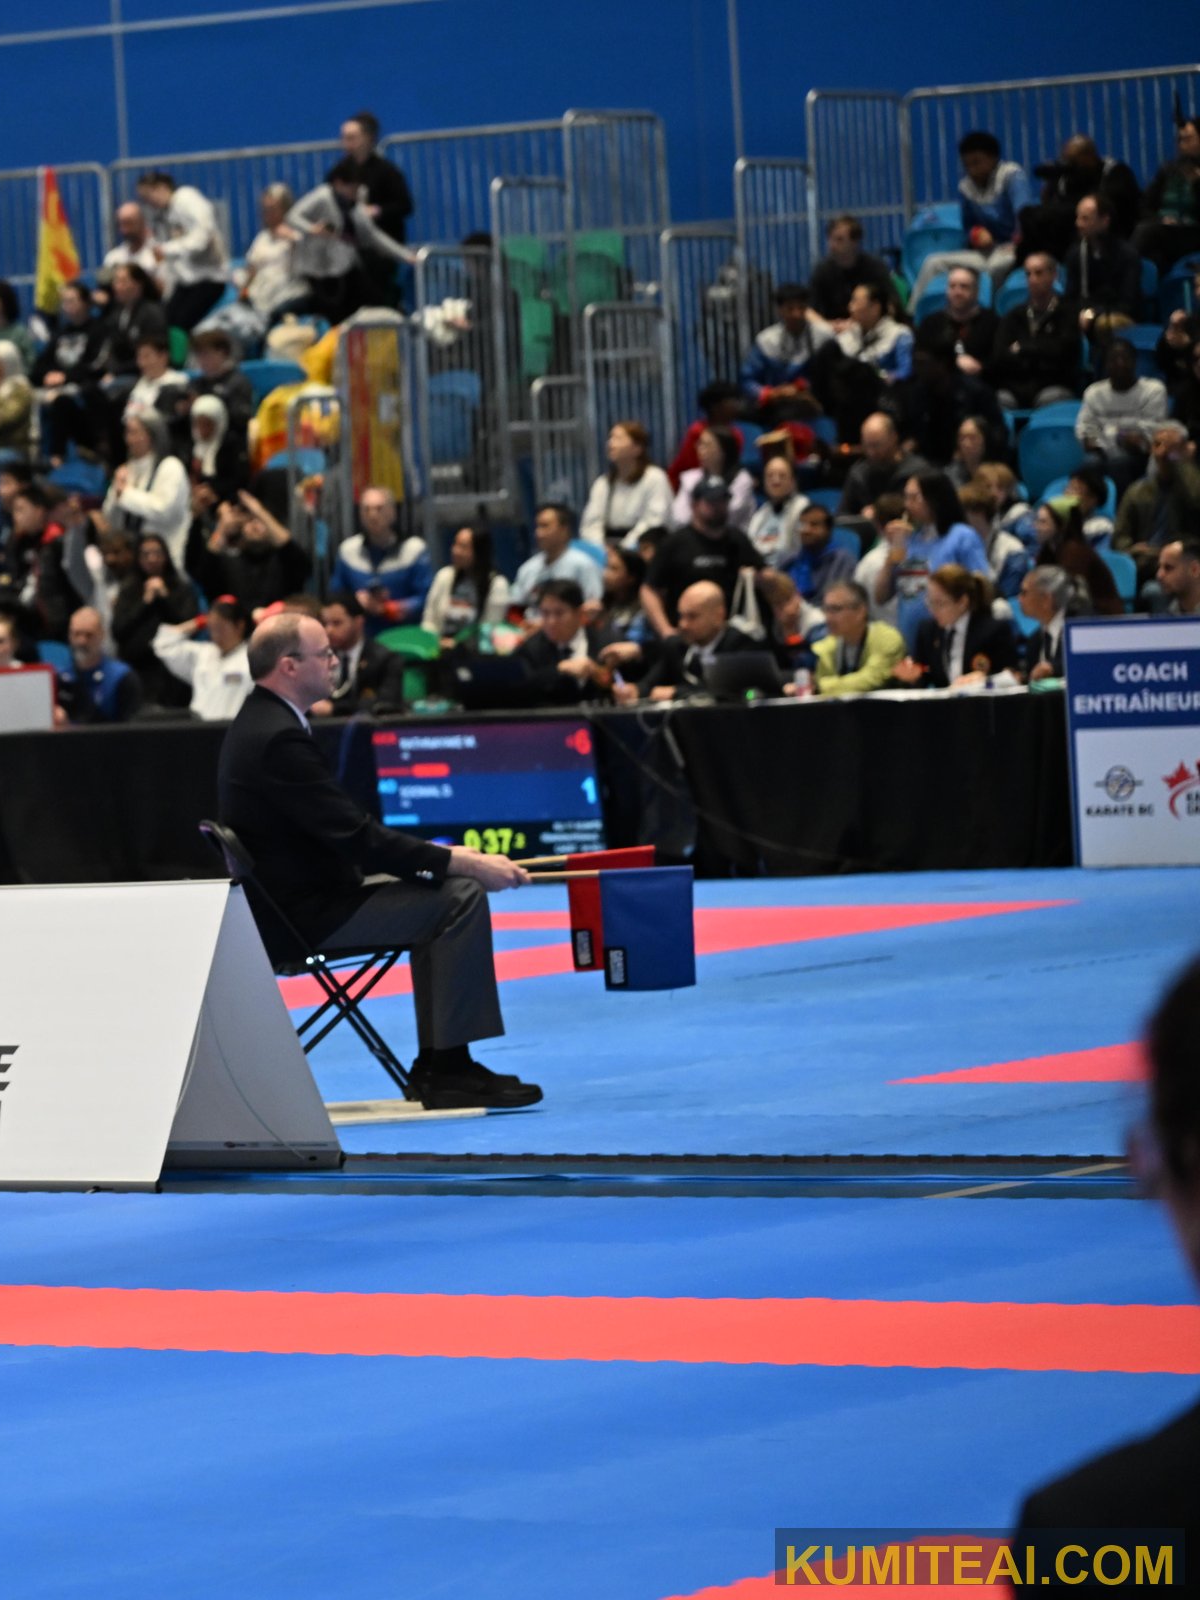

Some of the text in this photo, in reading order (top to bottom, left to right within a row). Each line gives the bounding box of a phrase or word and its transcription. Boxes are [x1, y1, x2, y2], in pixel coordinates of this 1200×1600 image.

[1113, 662, 1188, 683] COACH
[581, 776, 597, 804] 1
[1086, 805, 1135, 817] KARATE
